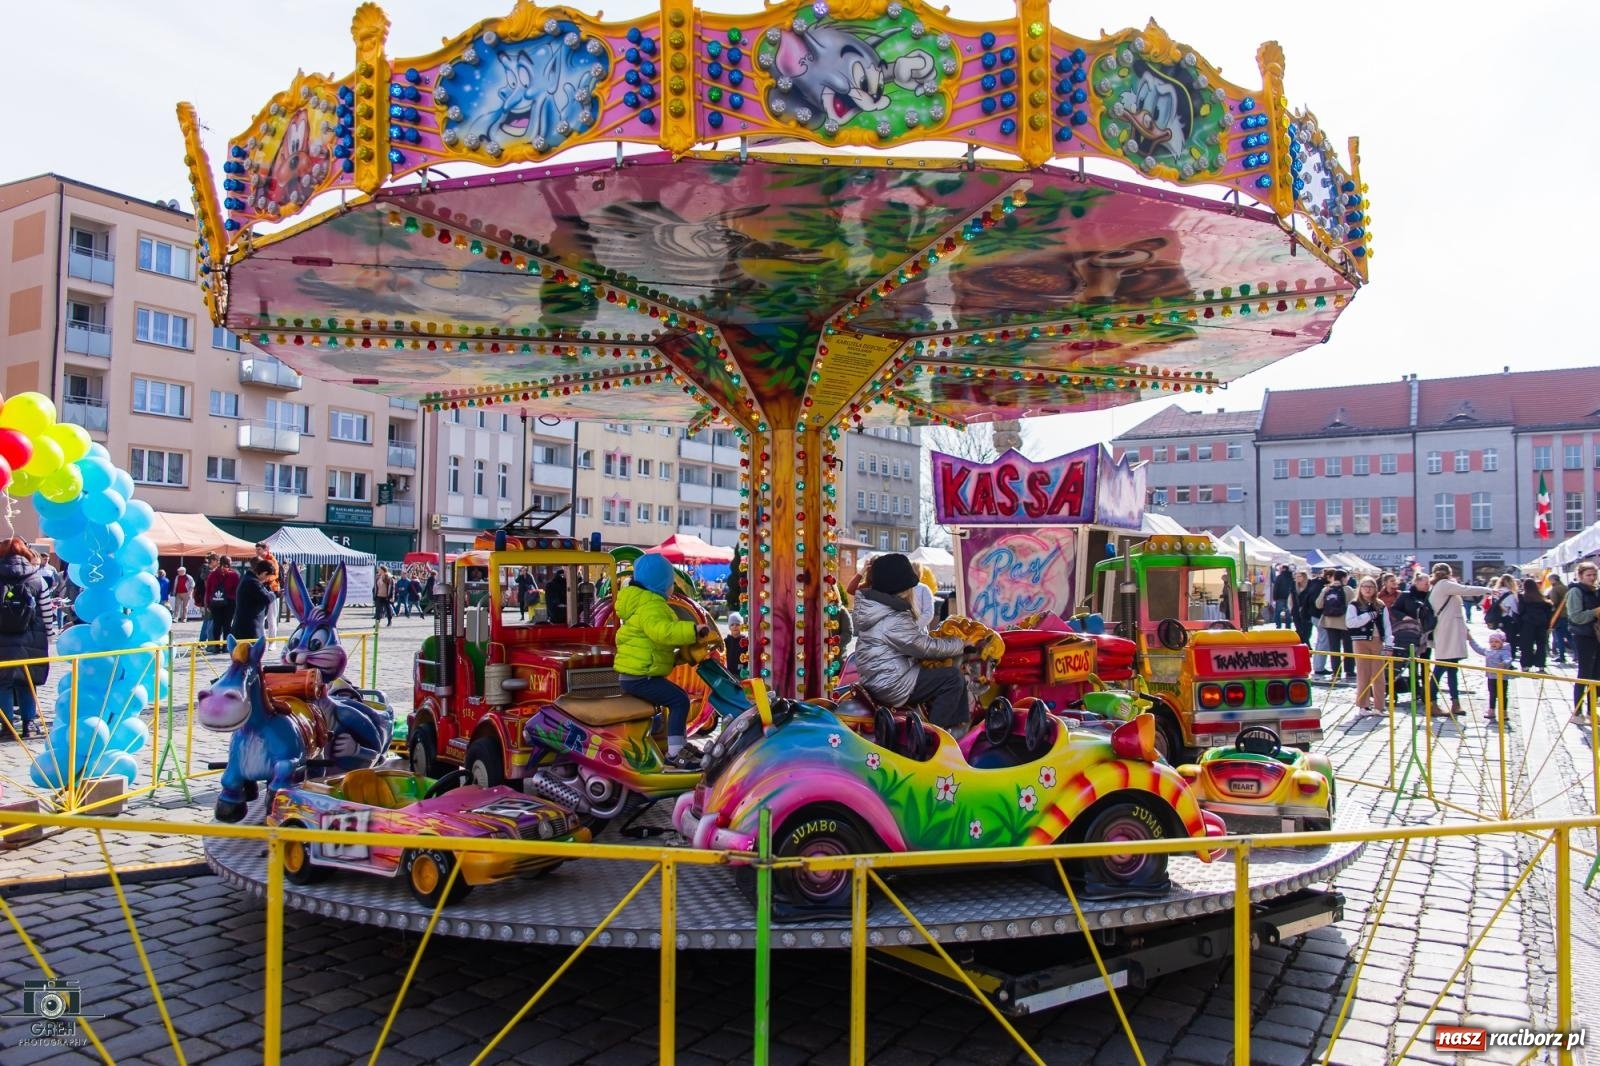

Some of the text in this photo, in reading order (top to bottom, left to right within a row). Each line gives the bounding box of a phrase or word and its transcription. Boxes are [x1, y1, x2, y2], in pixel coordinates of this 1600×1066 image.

[941, 460, 1086, 518] KASSA
[792, 820, 837, 844] JUMBO
[1132, 806, 1164, 839] JUMB
